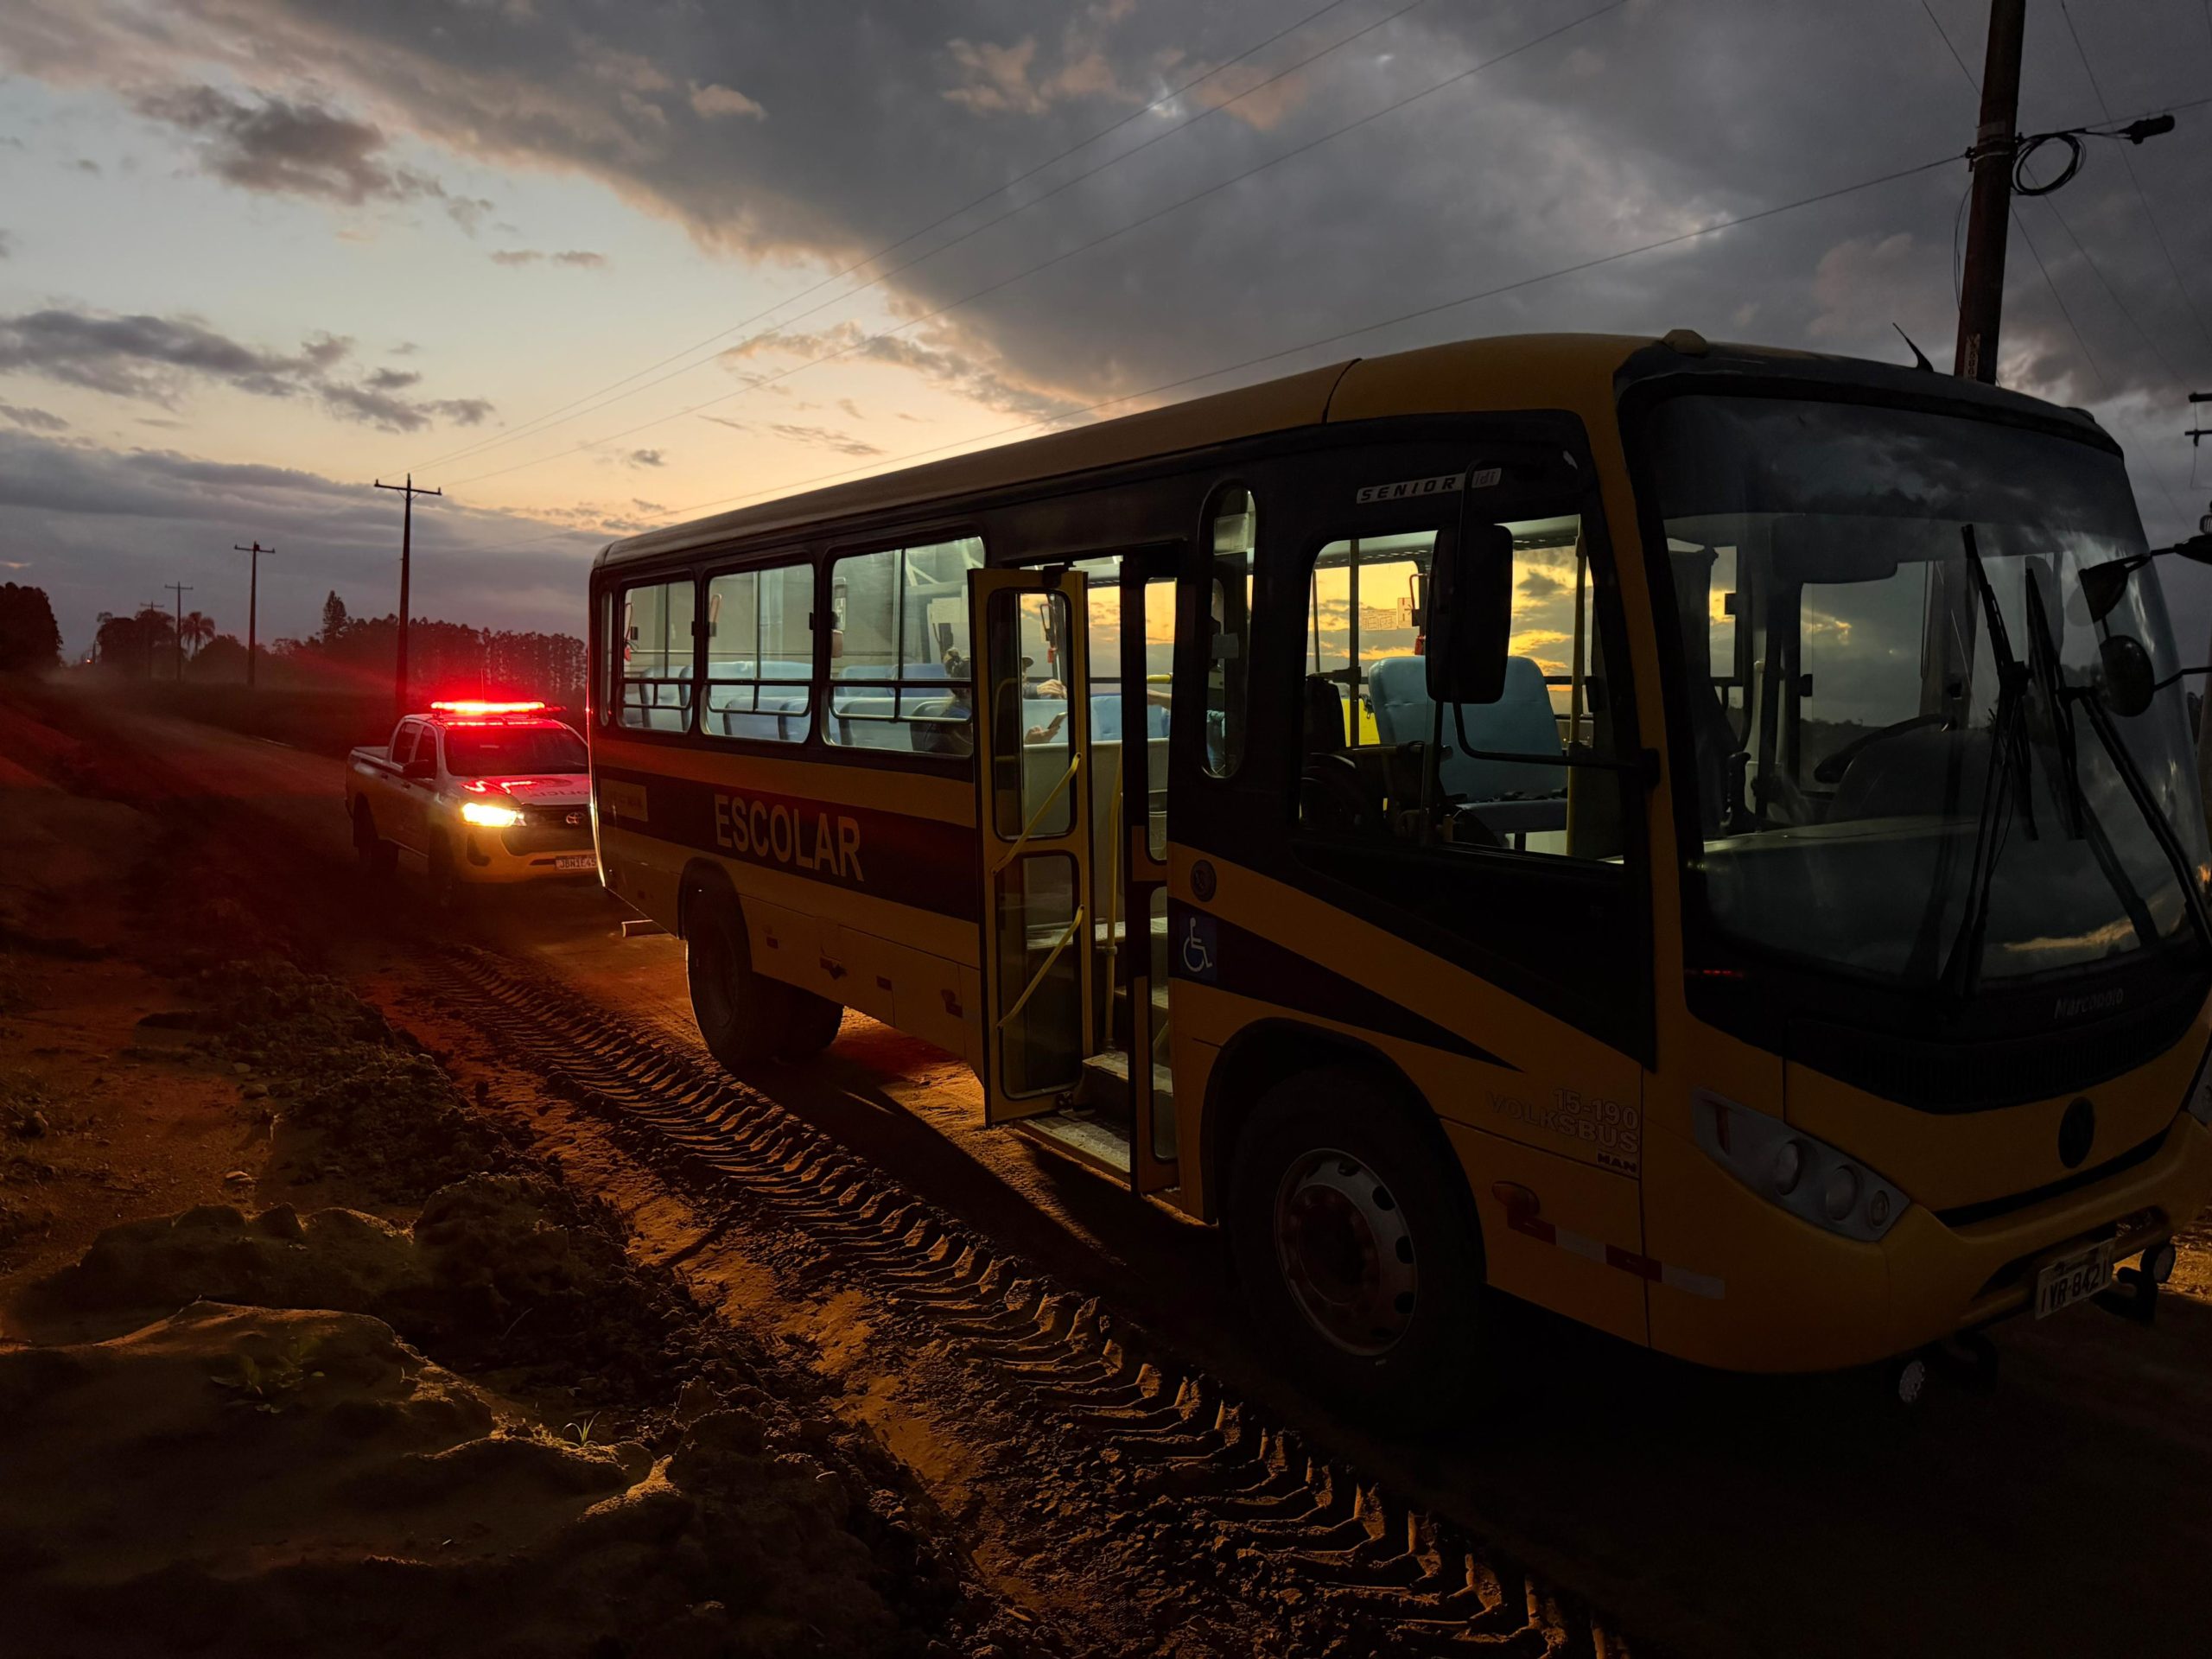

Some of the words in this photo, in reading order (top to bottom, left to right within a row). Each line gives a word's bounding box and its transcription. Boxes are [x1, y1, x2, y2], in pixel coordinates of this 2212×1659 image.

[1361, 477, 1456, 501] SENIOR
[714, 793, 865, 882] ESCOLAR
[1485, 1090, 1639, 1154] VOLKSBUS
[1554, 1089, 1639, 1130] 15-190
[1598, 1153, 1637, 1173] MAN
